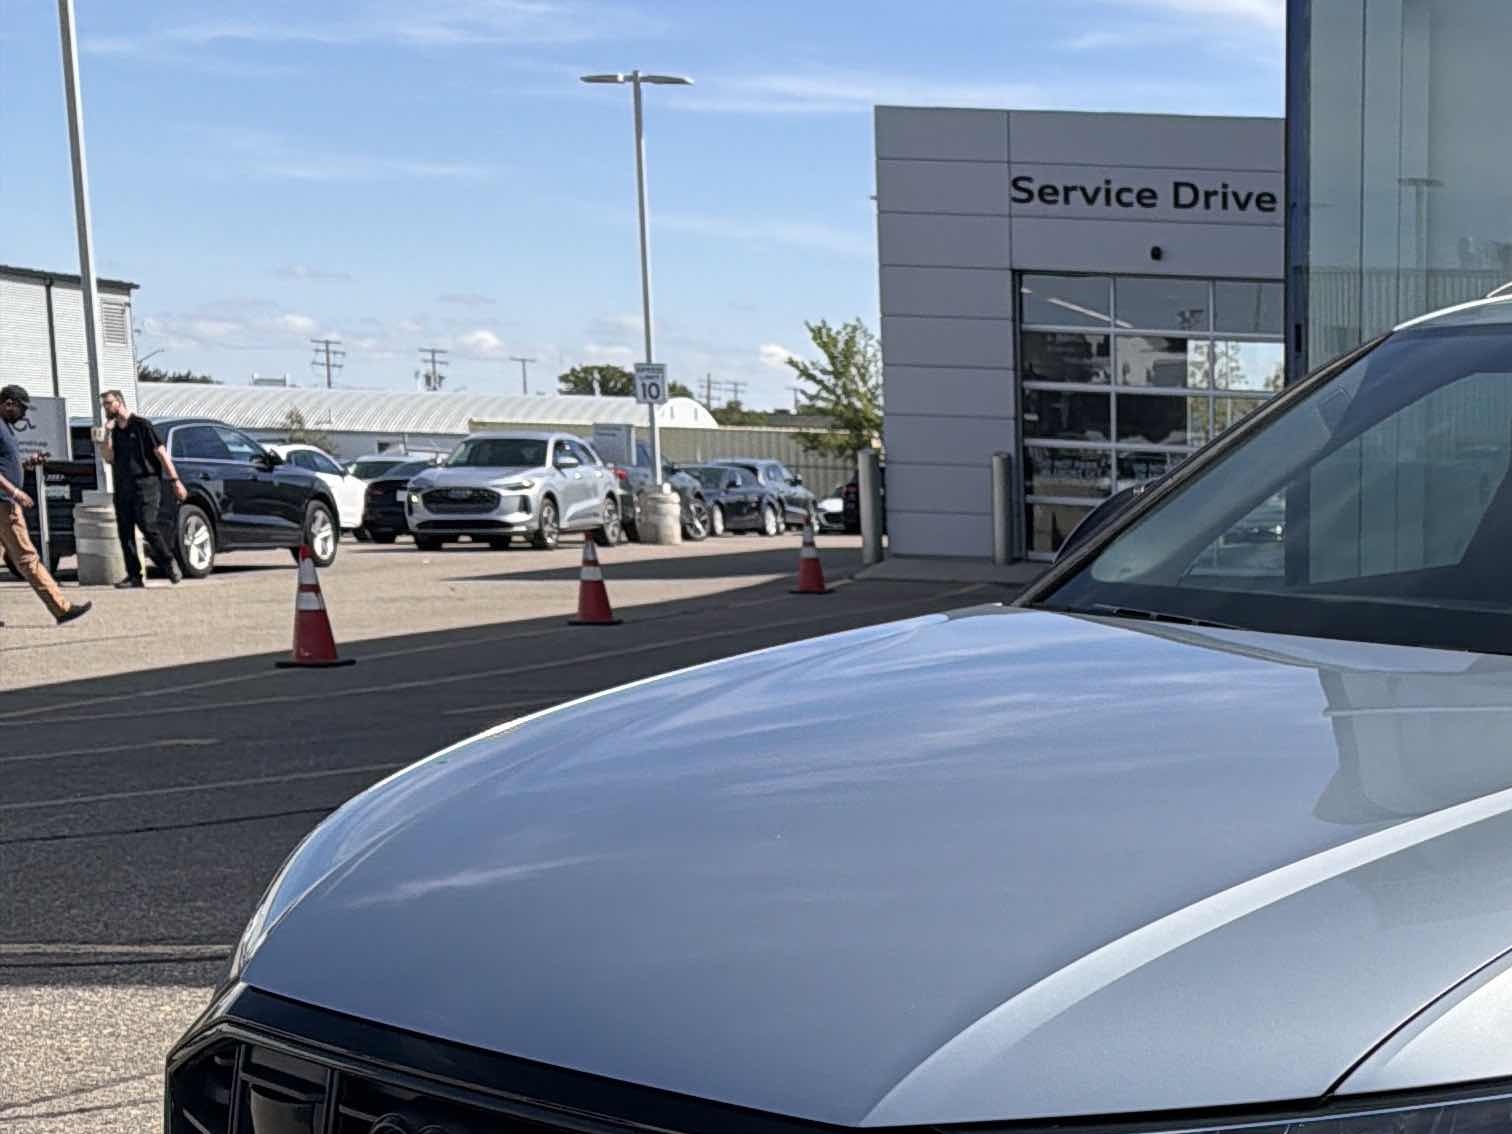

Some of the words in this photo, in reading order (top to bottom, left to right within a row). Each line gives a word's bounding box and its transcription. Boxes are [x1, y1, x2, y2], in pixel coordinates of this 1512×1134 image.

[1010, 175, 1158, 208] Service
[1172, 181, 1277, 213] Drive
[641, 382, 660, 400] 10
